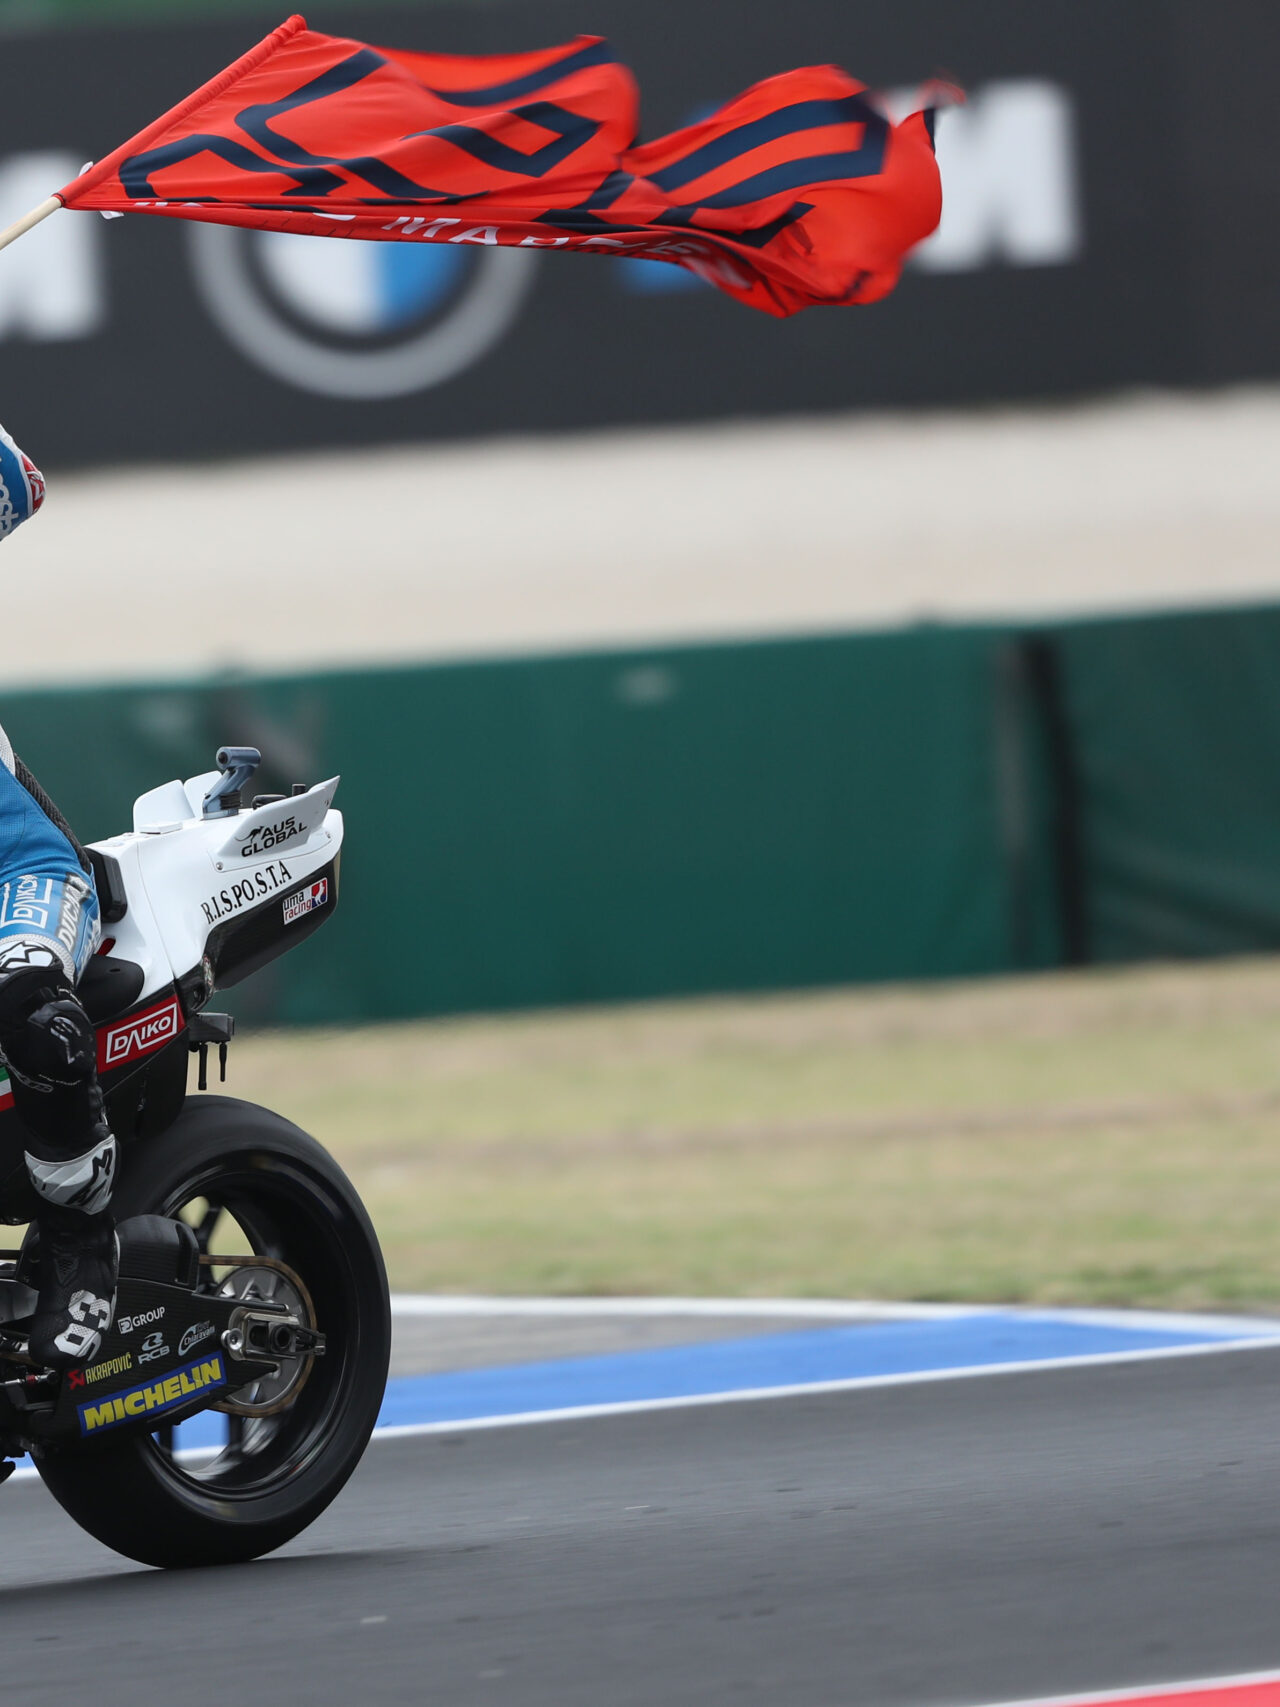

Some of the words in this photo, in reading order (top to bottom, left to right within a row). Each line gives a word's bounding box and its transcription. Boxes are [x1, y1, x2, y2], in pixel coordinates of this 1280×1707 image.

[261, 816, 296, 839] AUS
[241, 822, 308, 858] GLOBAL
[283, 890, 304, 912] uma
[284, 899, 312, 921] racing
[113, 1015, 172, 1052] DAIKO
[132, 1306, 166, 1328] GROUP
[137, 1345, 171, 1365] RCB
[84, 1357, 223, 1432] MICHELIN
